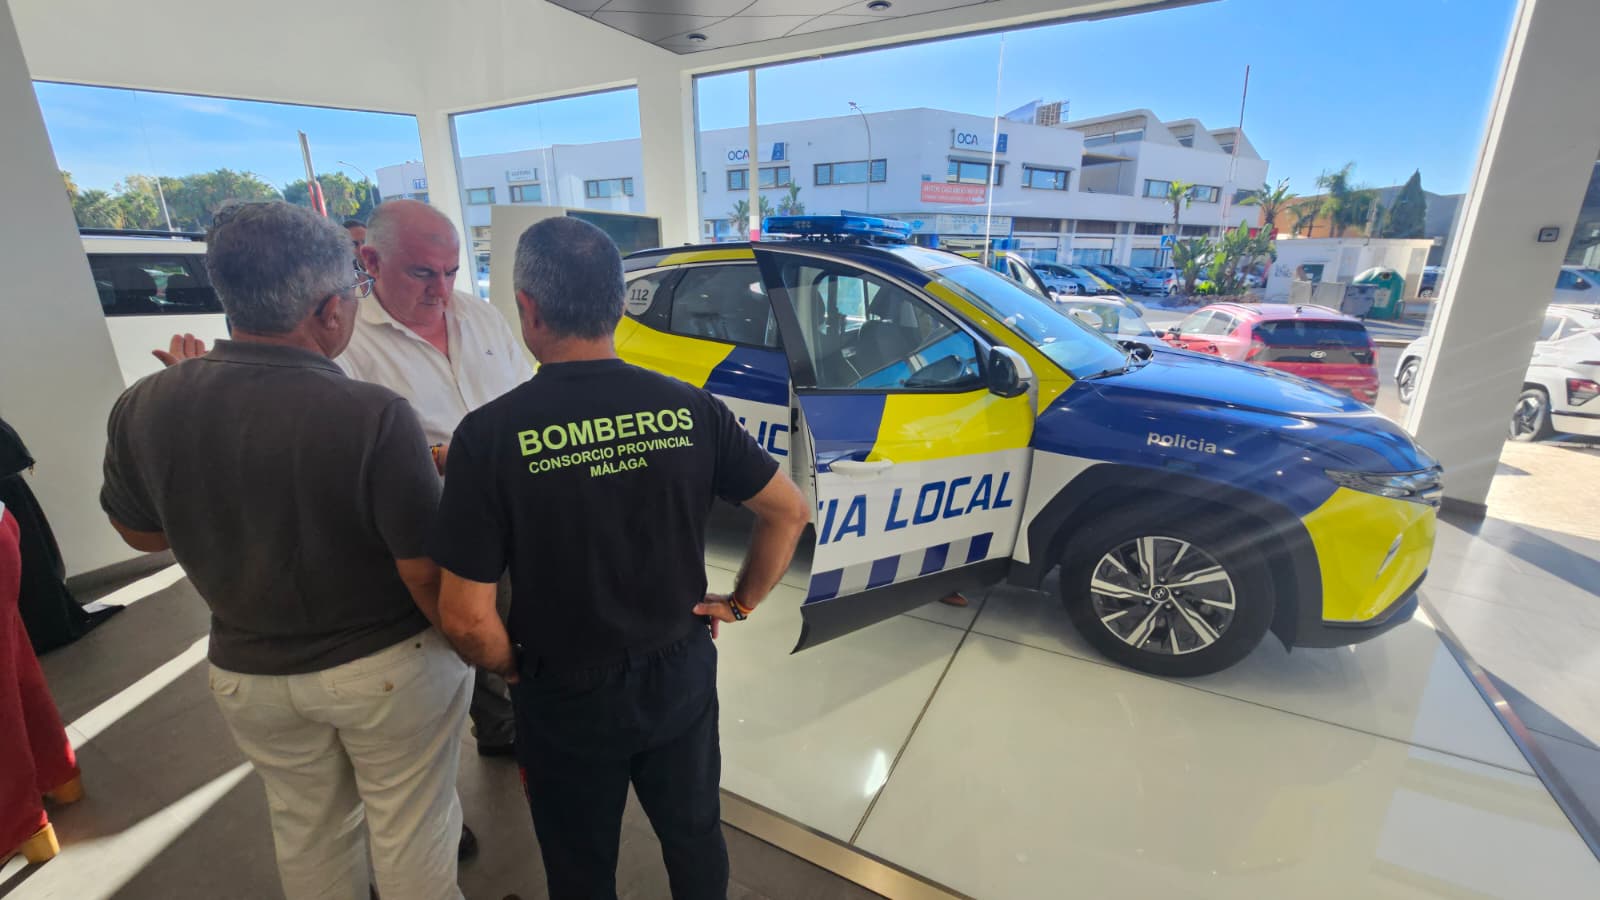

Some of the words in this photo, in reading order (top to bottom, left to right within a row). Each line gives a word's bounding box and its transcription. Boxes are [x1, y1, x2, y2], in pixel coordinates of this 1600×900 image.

[957, 132, 978, 145] OCA
[728, 149, 750, 160] OCA
[630, 288, 649, 301] 112
[518, 408, 694, 456] BOMBEROS
[739, 416, 789, 456] IC
[1146, 431, 1217, 455] policia
[528, 447, 614, 474] CONSORCIO
[618, 435, 694, 457] PROVINCIAL
[590, 456, 648, 478] MÁLAGA
[817, 494, 867, 546] IA
[884, 471, 1013, 532] LOCAL
